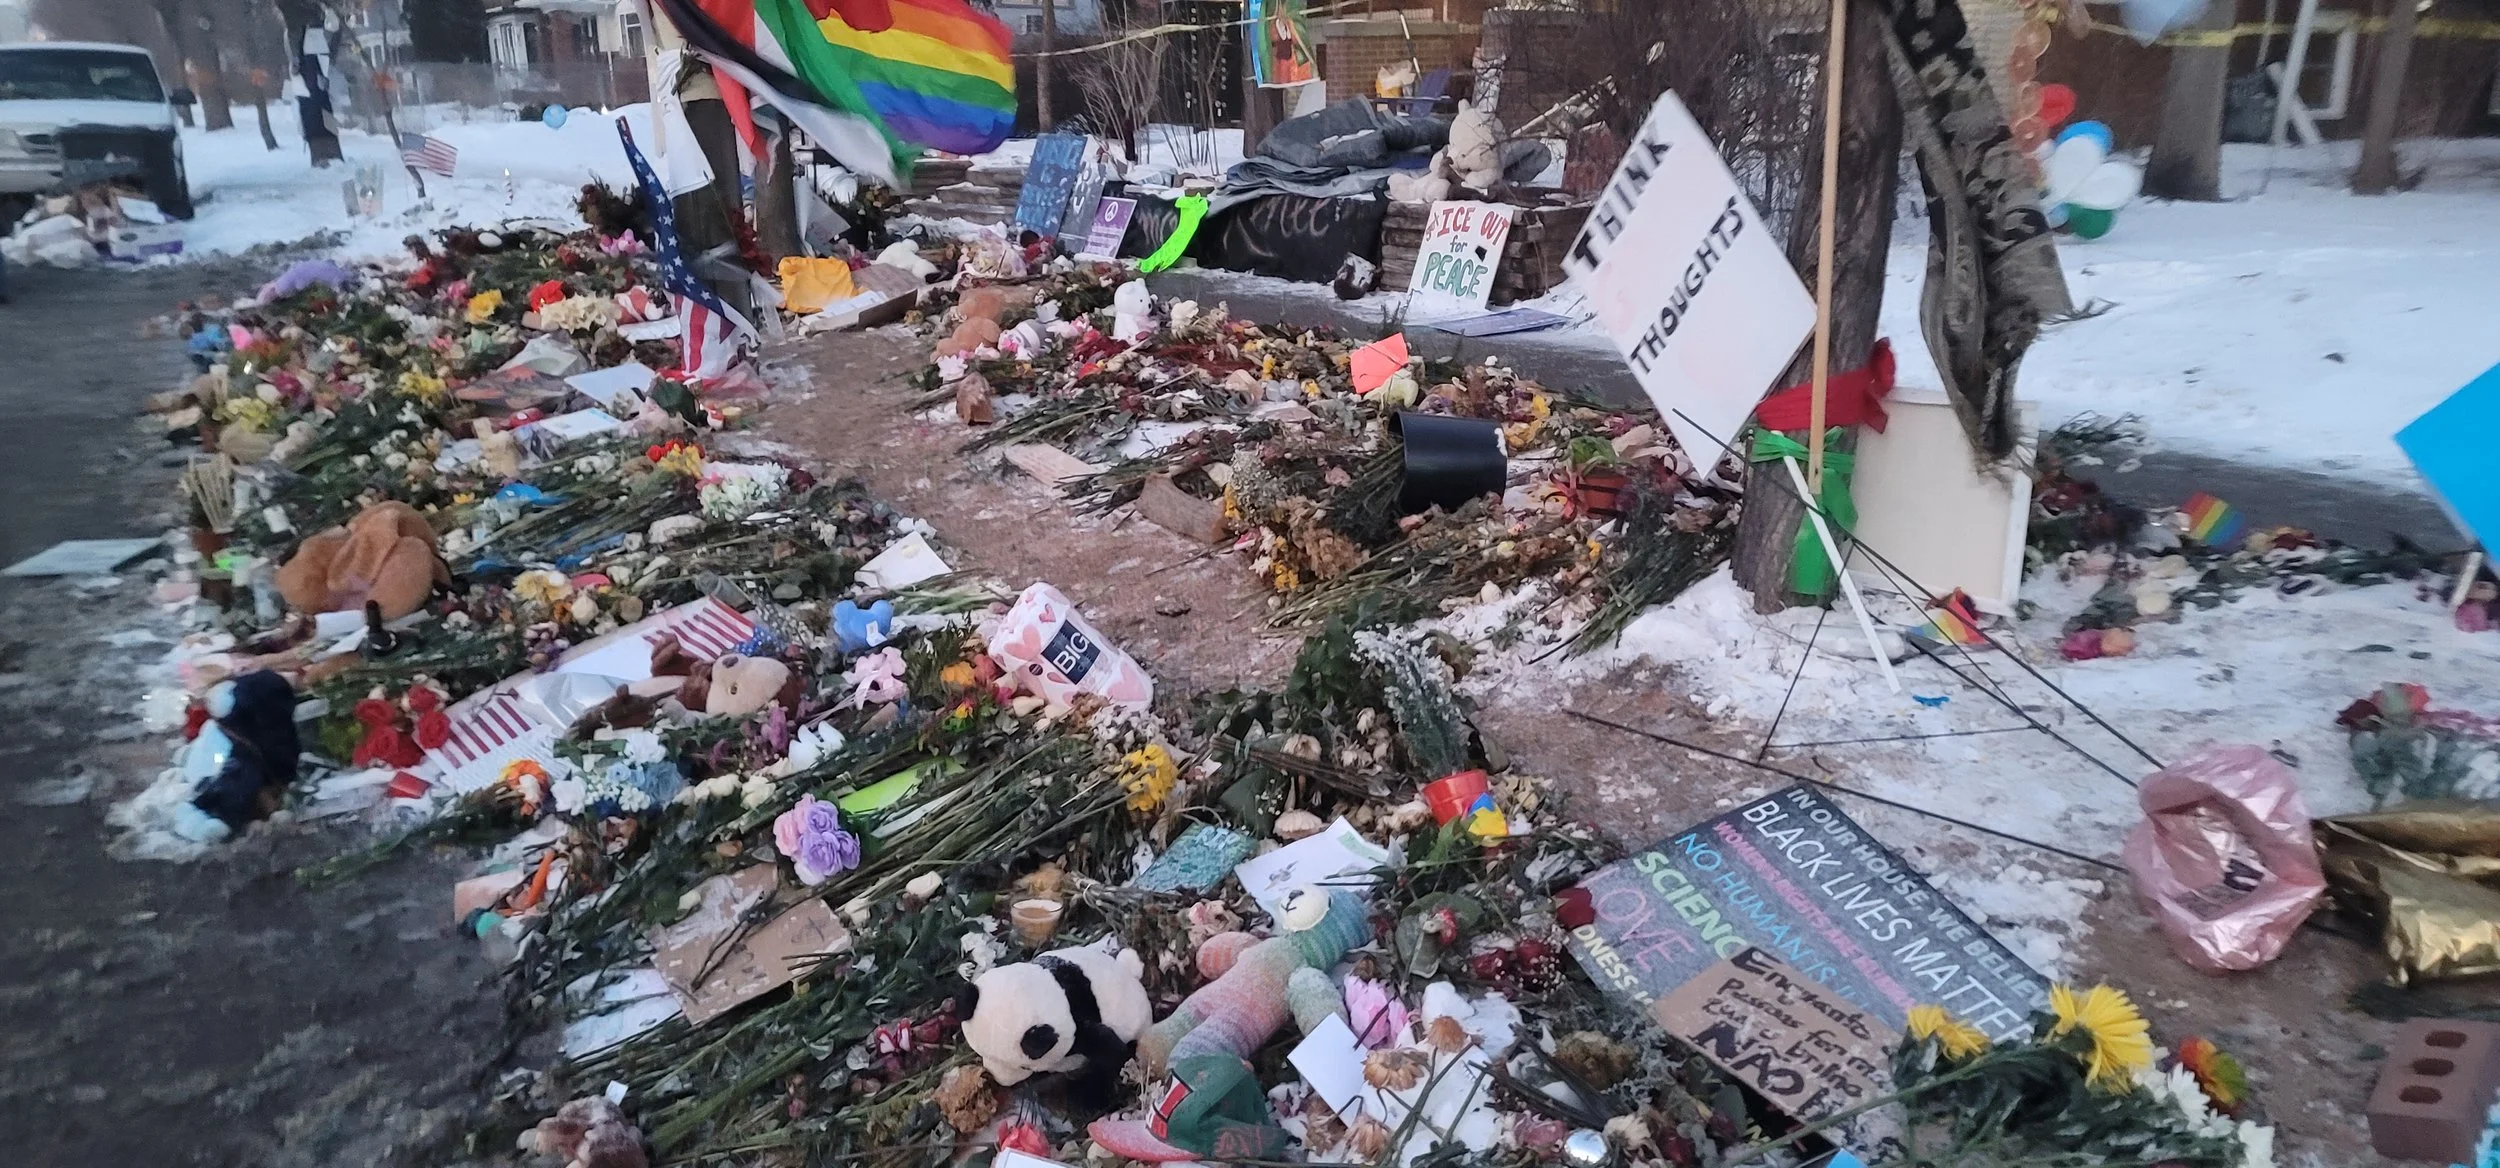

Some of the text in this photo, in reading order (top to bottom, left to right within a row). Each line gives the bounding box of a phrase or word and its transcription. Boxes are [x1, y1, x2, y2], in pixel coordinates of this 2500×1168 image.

[1437, 206, 1476, 238] ICE
[1480, 210, 1510, 246] OUT
[1449, 234, 1468, 253] for
[1573, 132, 1675, 271] THINK
[1421, 251, 1489, 299] PEACE
[1630, 195, 1746, 374] THOUGHTS
[1052, 631, 1090, 675] BIG
[1633, 850, 1749, 961] SCIENC
[1674, 832, 1838, 985] NO HUMAN IS
[1741, 799, 1842, 879] BLACK
[1820, 872, 1913, 942] LIVES
[1786, 788, 1817, 810] IN
[1809, 808, 1858, 846] OUR
[1928, 907, 1972, 943] WE
[1963, 939, 2055, 1016] BELIEV
